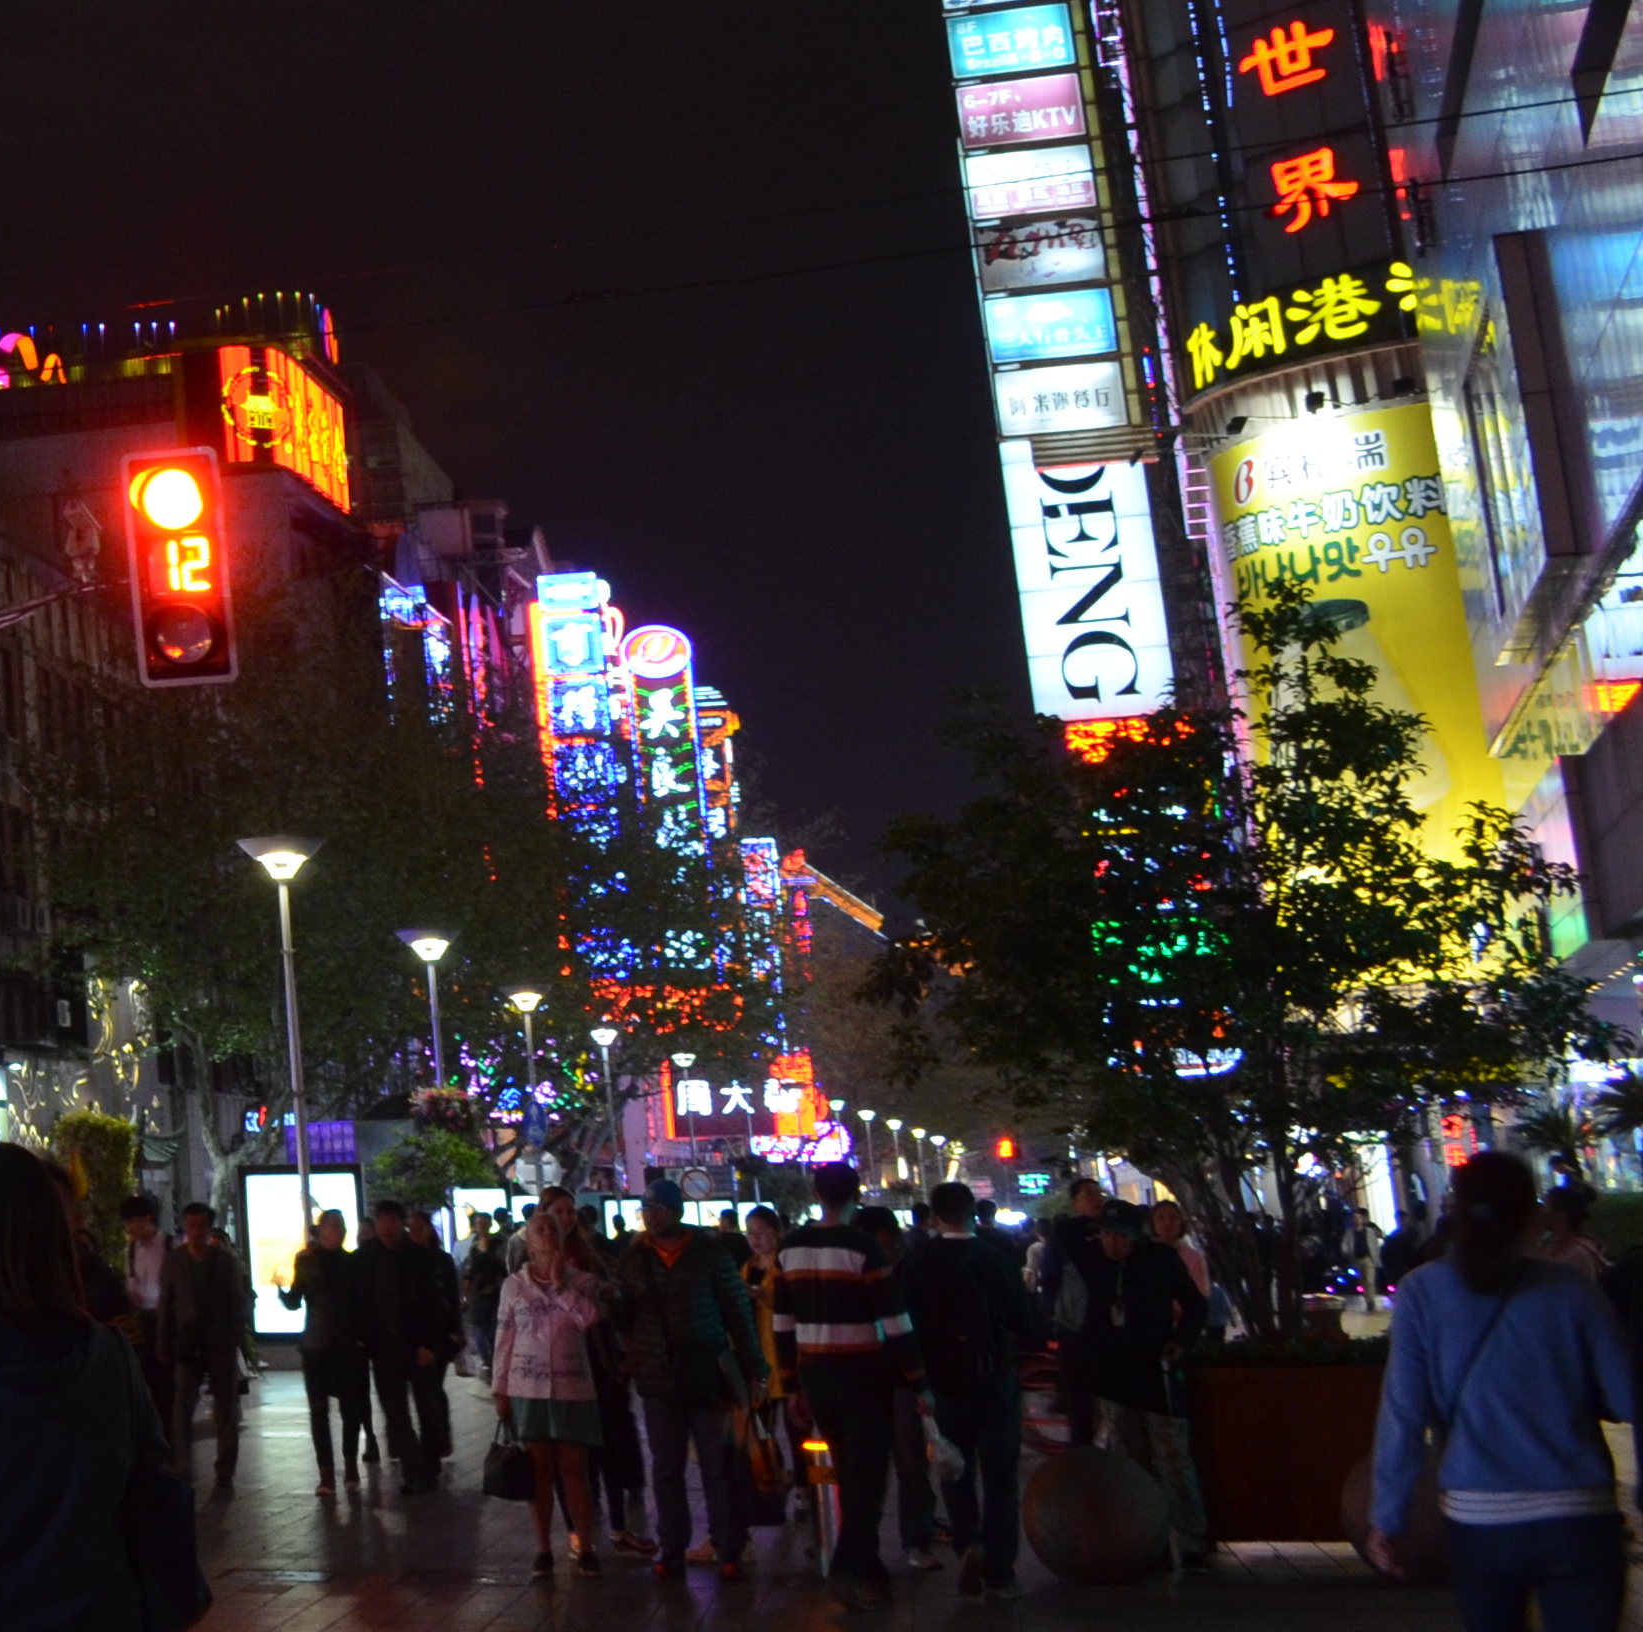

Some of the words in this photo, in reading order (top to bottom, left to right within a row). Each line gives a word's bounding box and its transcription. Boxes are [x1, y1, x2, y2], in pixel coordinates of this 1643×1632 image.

[962, 24, 1065, 56] 巴西烤肉
[967, 105, 1077, 138] 好乐迪KTV
[1223, 473, 1448, 563] 香蕉味牛奶饮料
[165, 535, 212, 592] 12
